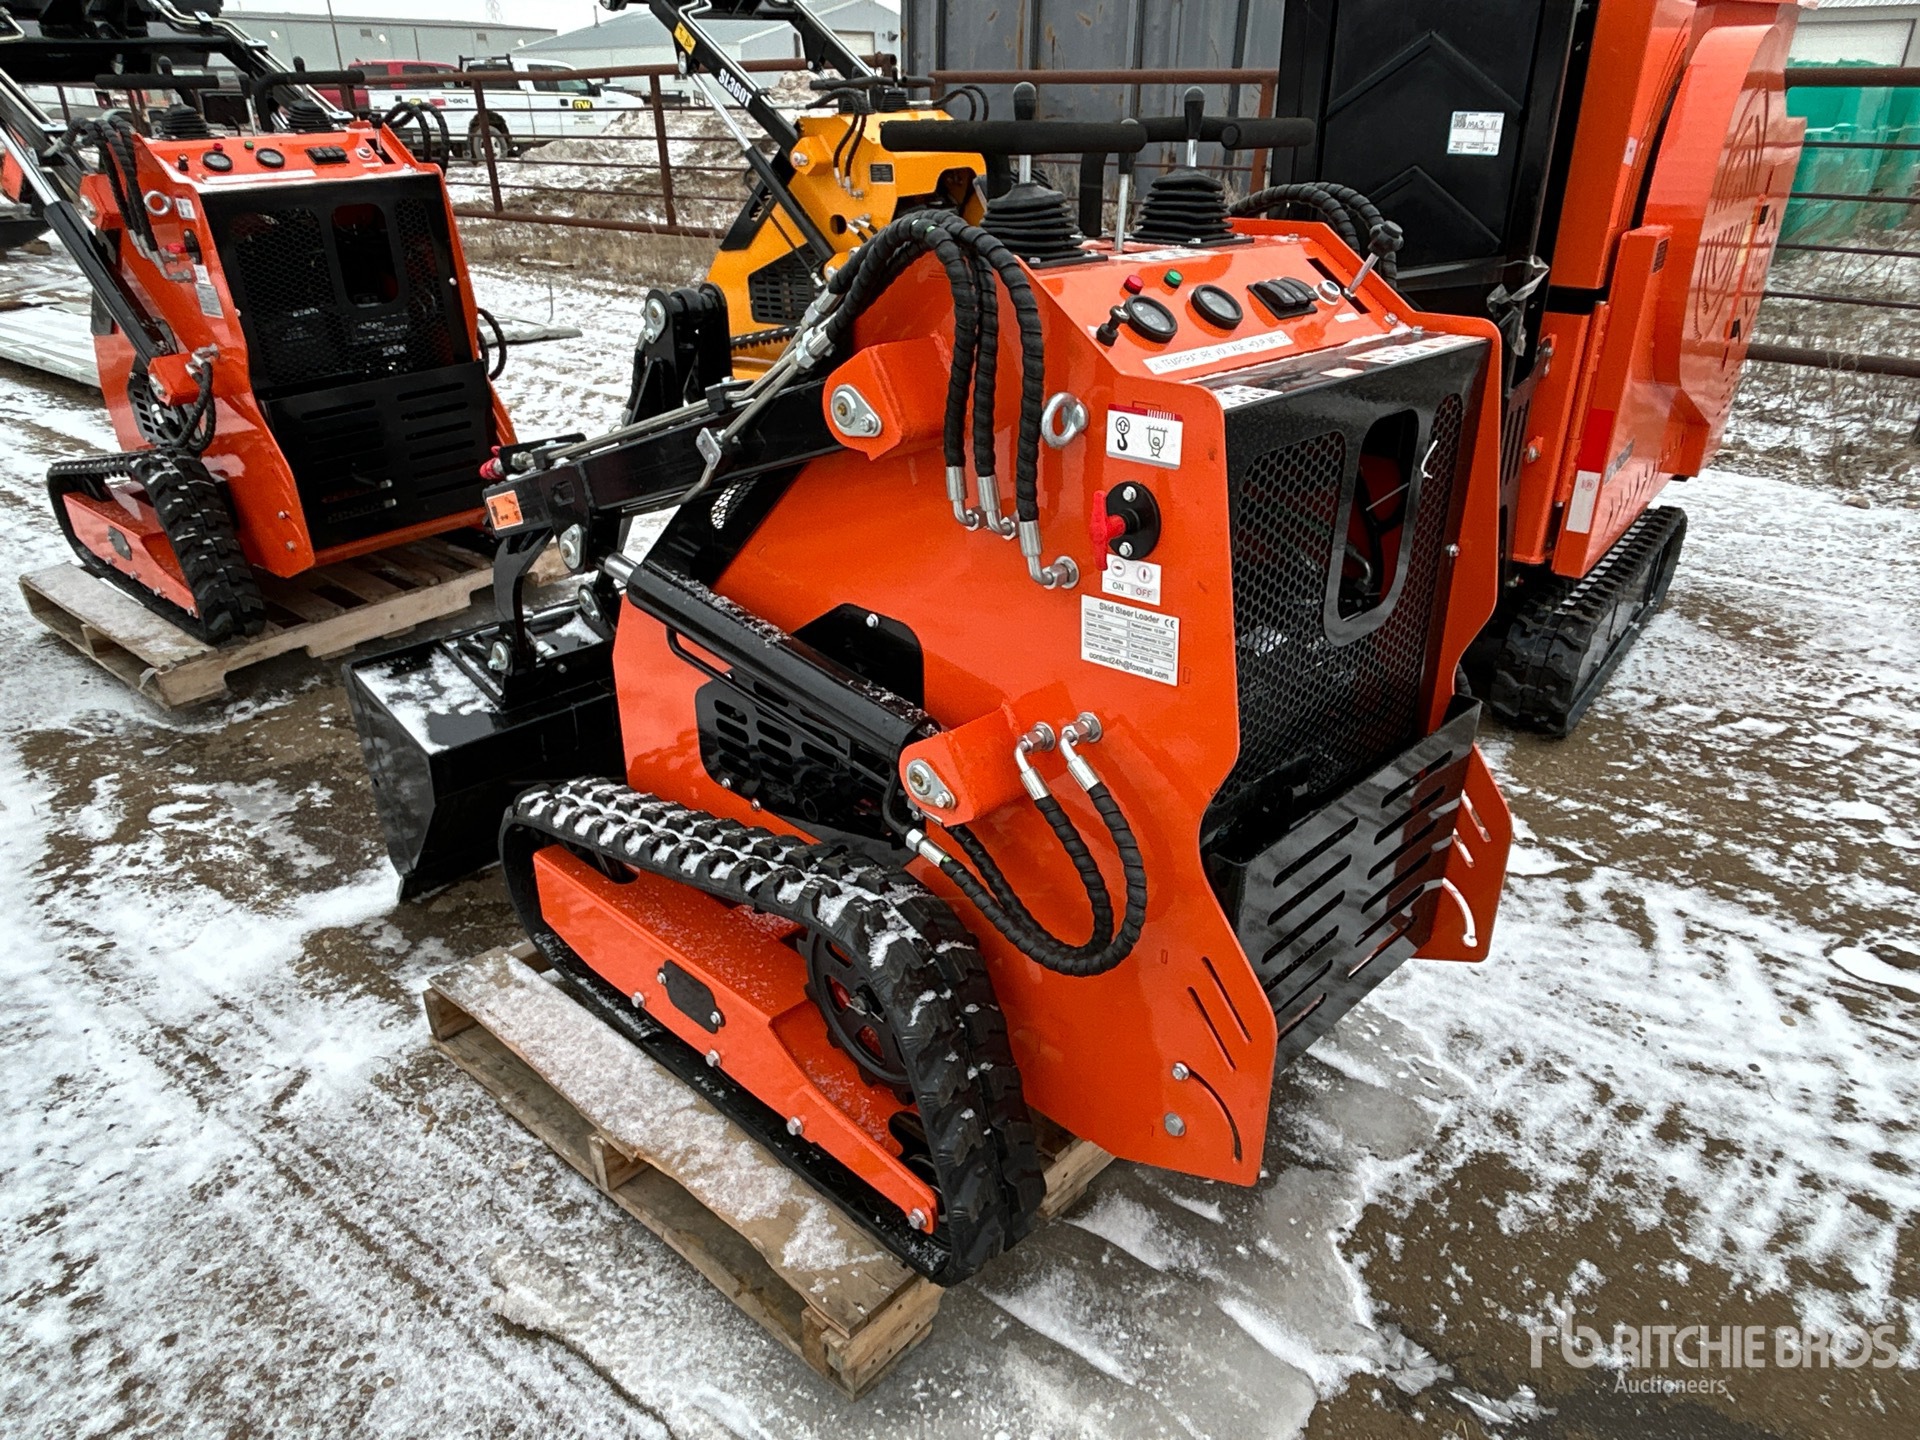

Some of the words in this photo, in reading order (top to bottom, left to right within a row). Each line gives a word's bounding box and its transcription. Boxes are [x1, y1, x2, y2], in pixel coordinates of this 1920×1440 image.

[718, 68, 753, 107] SL360T
[1112, 581, 1124, 591] ON
[1136, 587, 1152, 598] OFF
[1099, 601, 1114, 613] Skid
[1115, 605, 1134, 618] Steer
[1134, 611, 1160, 624] Loader
